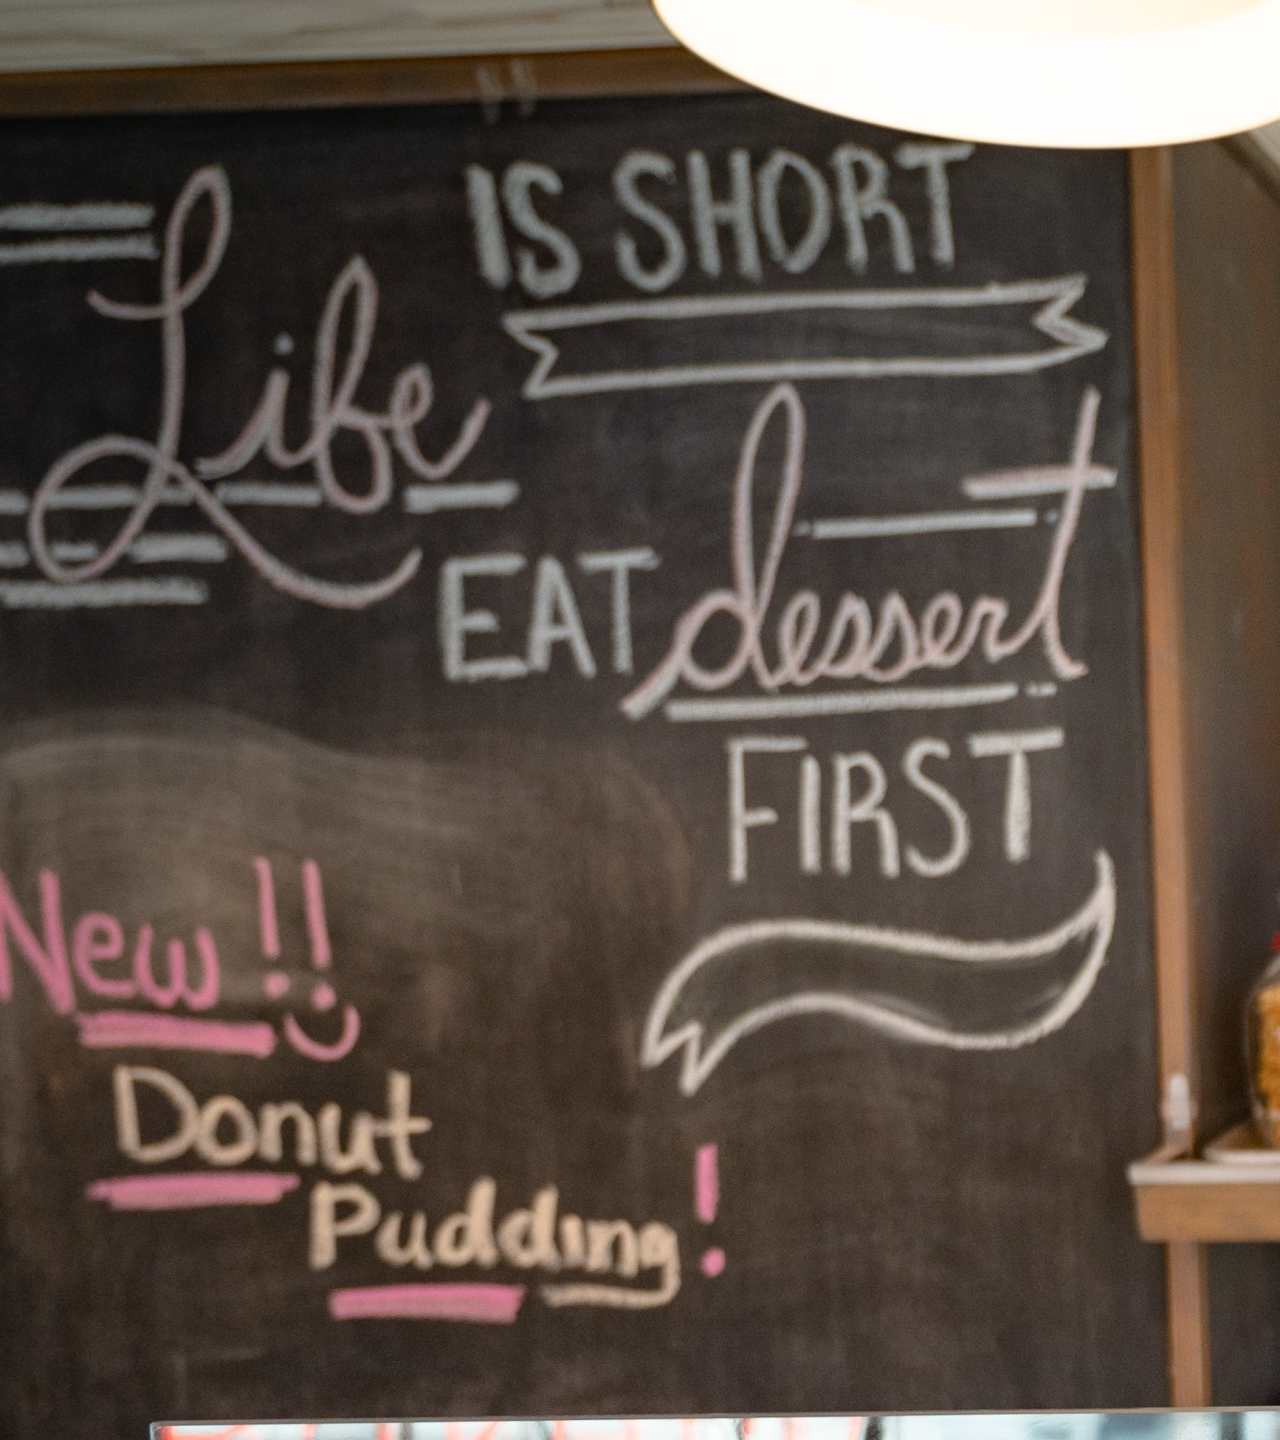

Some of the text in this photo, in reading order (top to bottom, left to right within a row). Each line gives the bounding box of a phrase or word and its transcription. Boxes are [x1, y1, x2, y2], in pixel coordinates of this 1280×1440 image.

[466, 143, 975, 297] IS SHORT
[28, 166, 489, 608] Life
[439, 383, 1118, 720] EAT dessert
[726, 728, 1066, 884] FIRST
[113, 1064, 431, 1181] Donut
